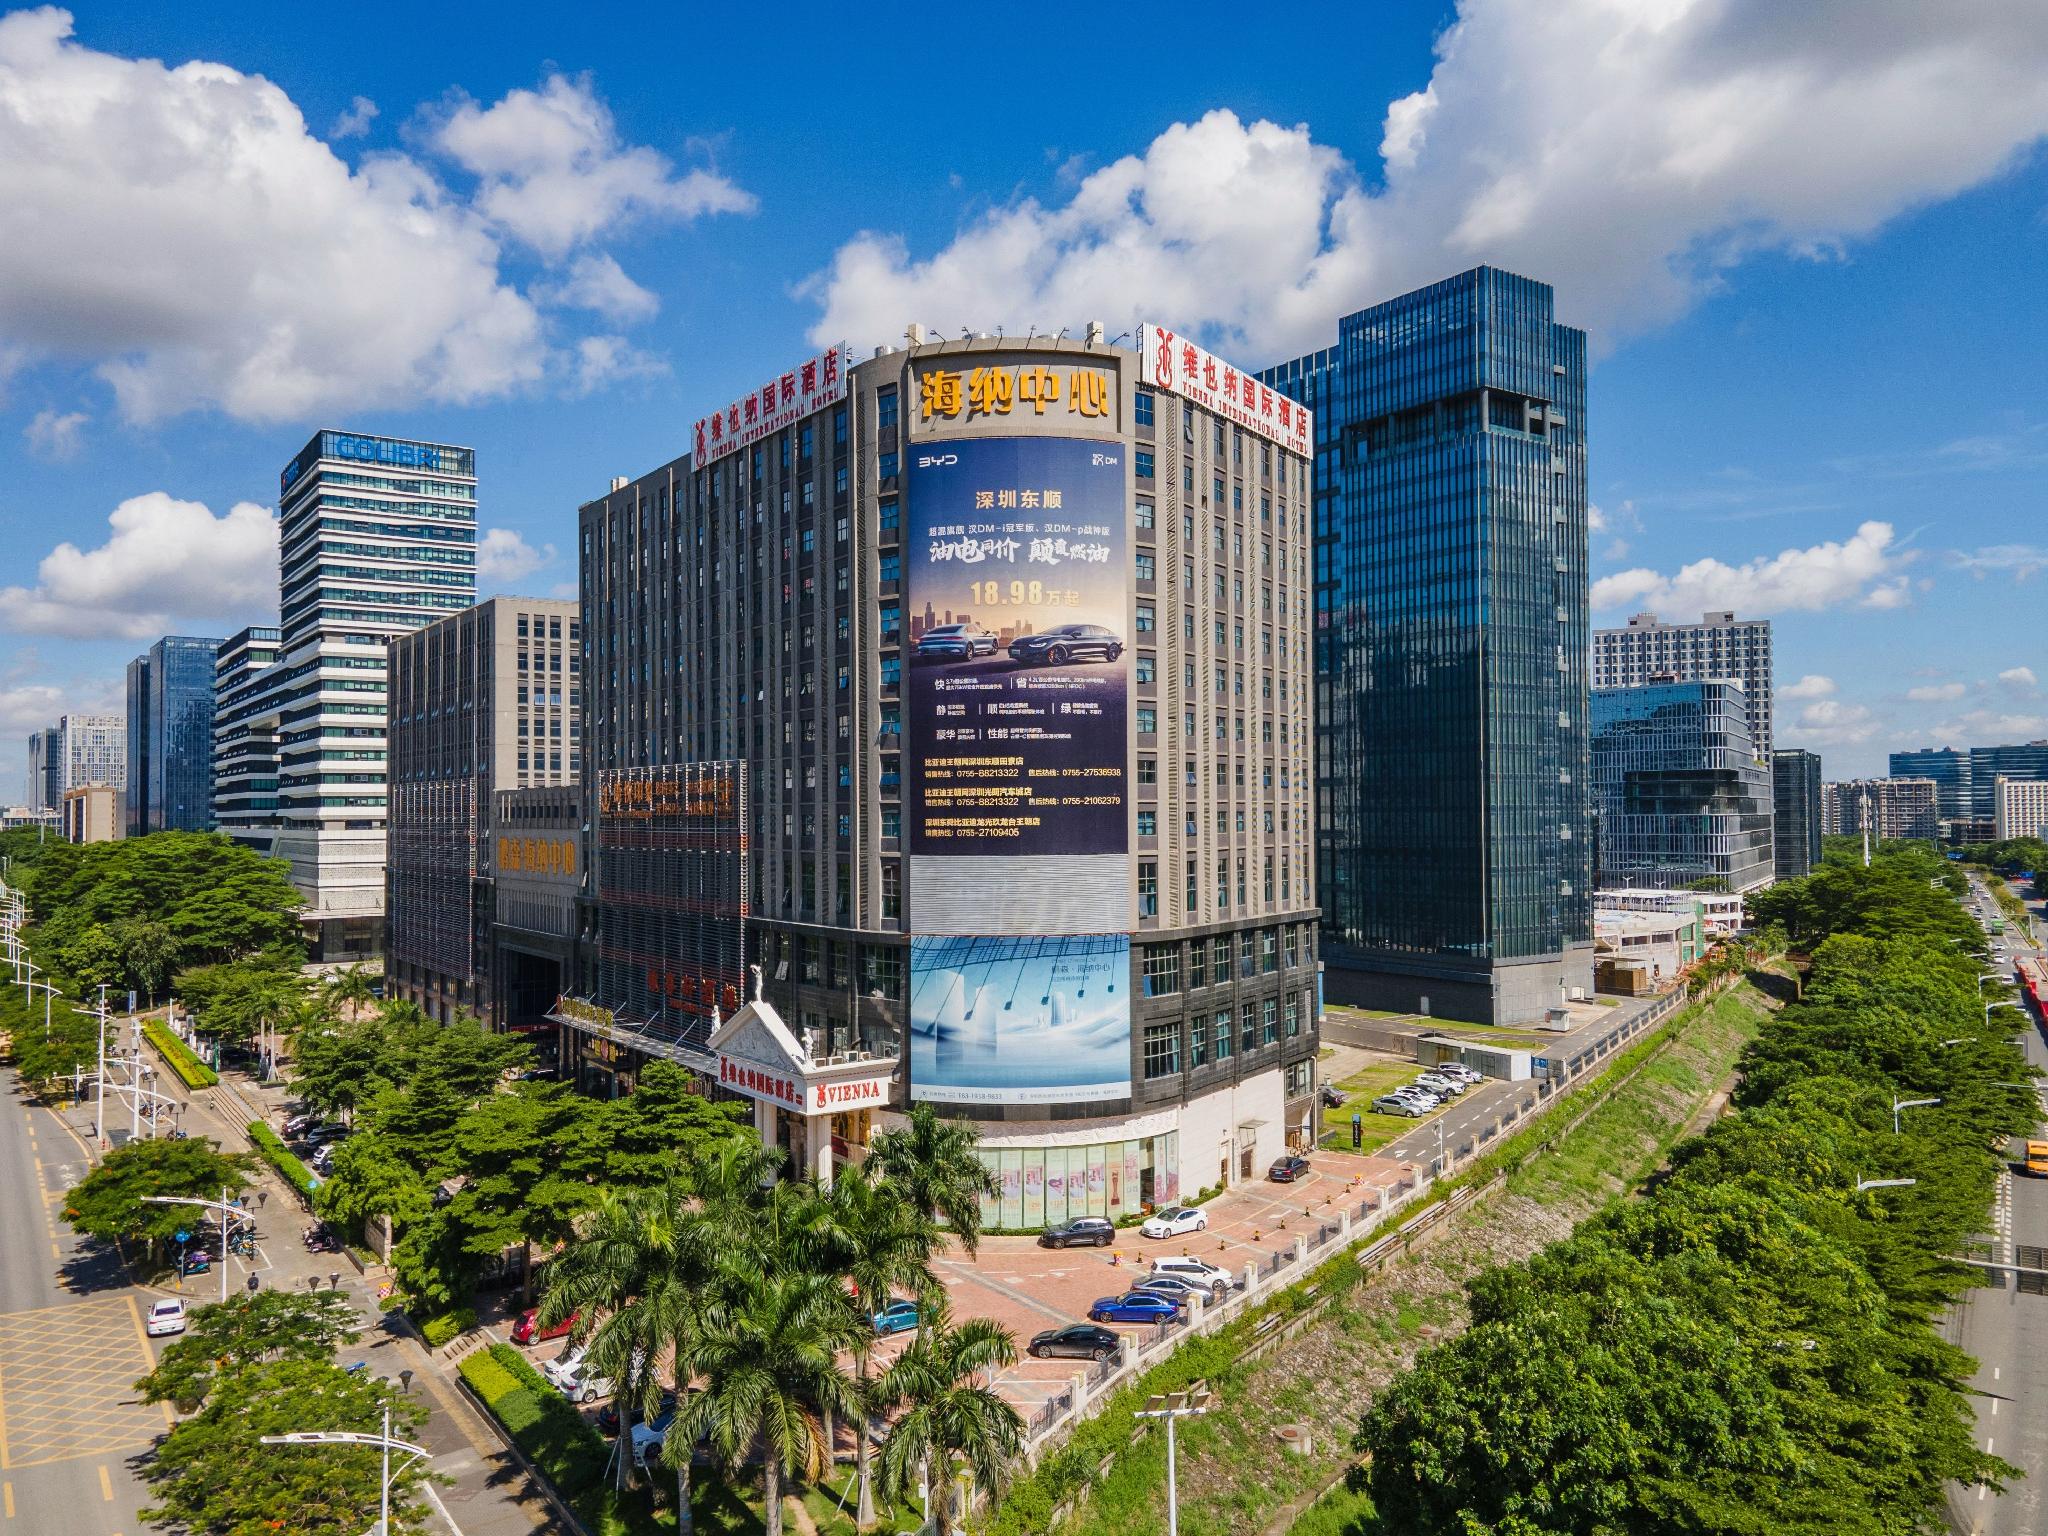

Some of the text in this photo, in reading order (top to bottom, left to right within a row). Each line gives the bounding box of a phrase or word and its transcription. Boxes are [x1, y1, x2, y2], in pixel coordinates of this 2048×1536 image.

[711, 348, 838, 442] 维也纳国际酒店
[921, 367, 1109, 417] 海纳中心
[1182, 342, 1307, 440] 维也纳国际酒店
[336, 437, 441, 468] COLIBRI
[918, 454, 958, 468] BYD
[975, 490, 1062, 509] 深圳东顺
[928, 535, 1021, 563] 油电同价
[934, 678, 945, 690] 快
[1016, 677, 1027, 689] 省
[936, 704, 946, 716] 静
[987, 728, 1009, 740] 性能
[728, 1062, 795, 1104] 维也纳国际酒店
[827, 1081, 880, 1104] VIENNA
